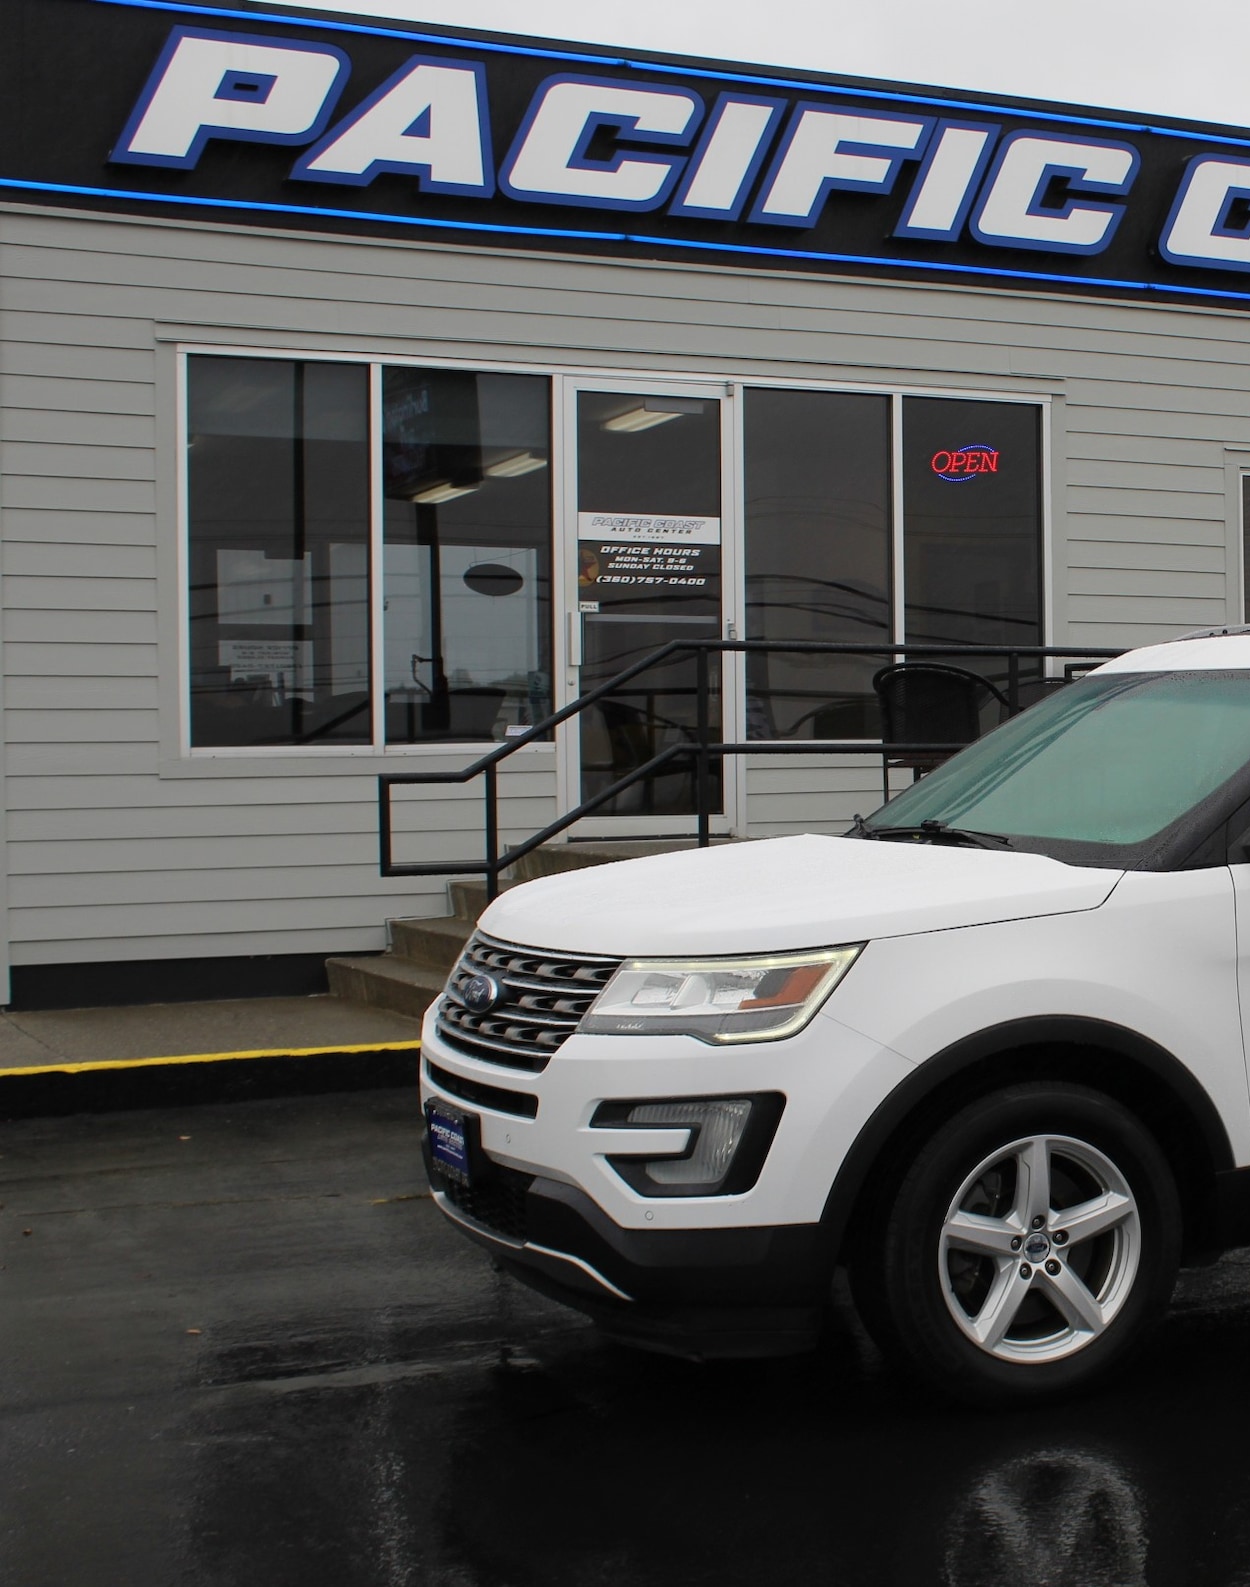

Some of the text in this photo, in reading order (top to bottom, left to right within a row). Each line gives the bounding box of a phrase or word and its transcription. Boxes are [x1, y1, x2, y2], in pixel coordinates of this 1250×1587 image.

[109, 25, 1142, 256] PACIFIC
[931, 450, 1000, 473] OPEN
[592, 516, 706, 531] PACIFIC COAST
[600, 546, 702, 557] OFFICE HOURS
[614, 556, 665, 564] MON-SAT.
[607, 562, 695, 572] SUNDAY CLOSED
